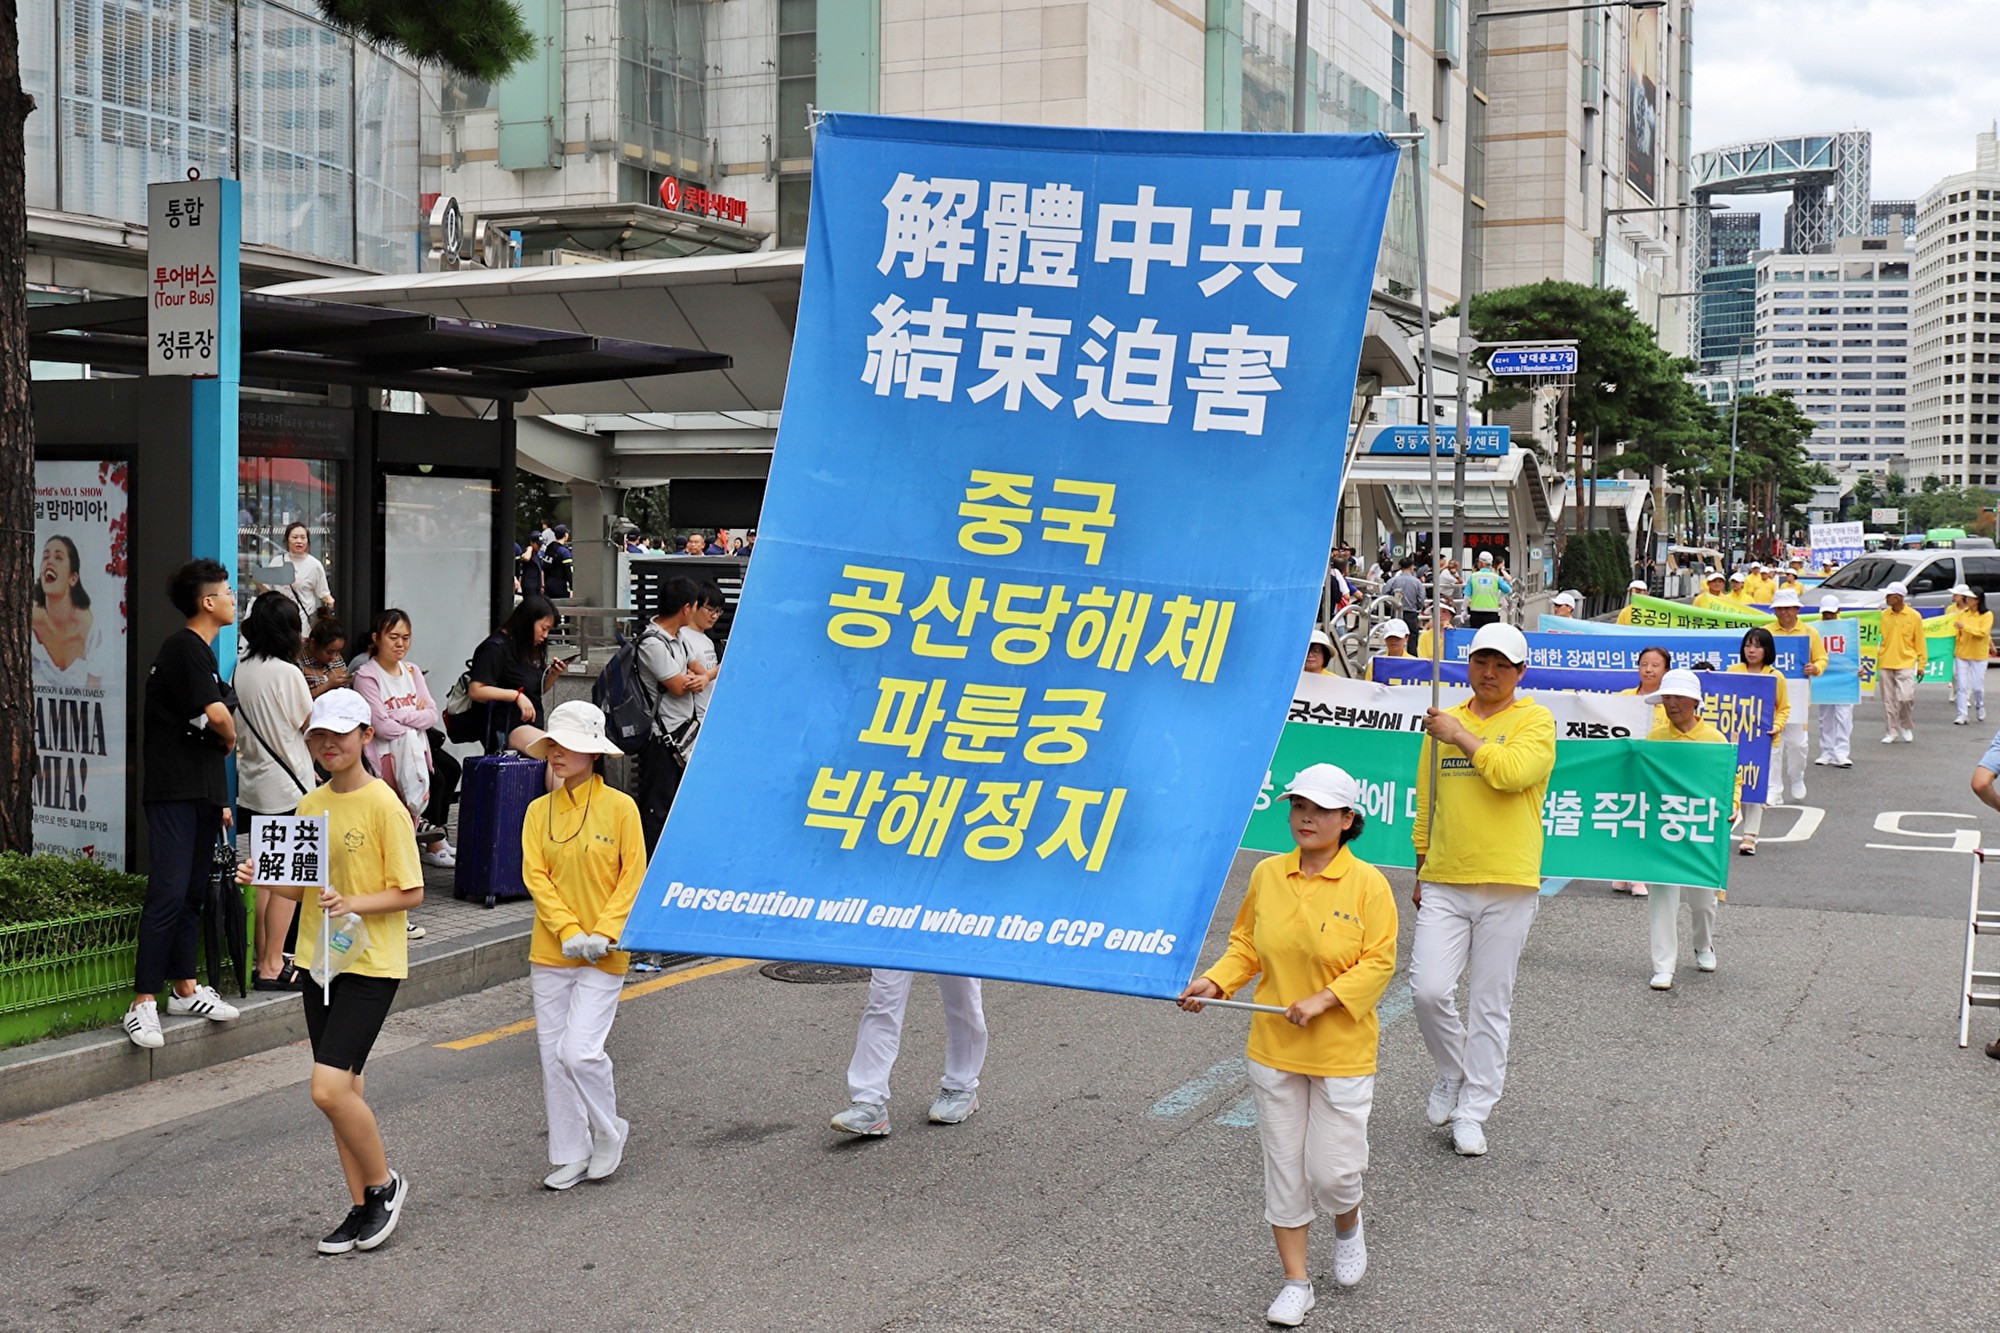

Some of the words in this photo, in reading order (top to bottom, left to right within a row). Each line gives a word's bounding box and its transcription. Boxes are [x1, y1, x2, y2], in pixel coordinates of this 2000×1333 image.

[165, 197, 204, 228] 통합
[876, 172, 1303, 299] 解體中共
[154, 264, 216, 290] 투어버스
[155, 291, 186, 308] (Tour
[189, 289, 214, 306] Bus)
[157, 329, 214, 360] 정류장
[860, 293, 1290, 436] 結束迫害
[60, 487, 77, 497] NO.1
[80, 487, 103, 497] SHOW
[47, 500, 108, 522] 맘마미아!
[957, 469, 1117, 566] 중국
[1463, 534, 1505, 547] 동지하
[826, 564, 1236, 684] 공산당해체
[858, 677, 1107, 764] 파룬궁
[1695, 691, 1763, 742] 복하자!
[1443, 760, 1470, 768] FALUN
[1737, 760, 1760, 790] arty
[804, 767, 1127, 872] 박해정지
[1591, 791, 1650, 839] 즉각
[1657, 796, 1720, 843] 중단
[262, 819, 319, 851] 中共
[257, 851, 319, 882] 解體
[661, 882, 815, 920] Persecution
[815, 897, 868, 925] will
[866, 903, 922, 930] end
[920, 908, 995, 938] when
[996, 914, 1045, 943] the
[1045, 918, 1105, 948] CCP
[1104, 928, 1177, 956] ends
